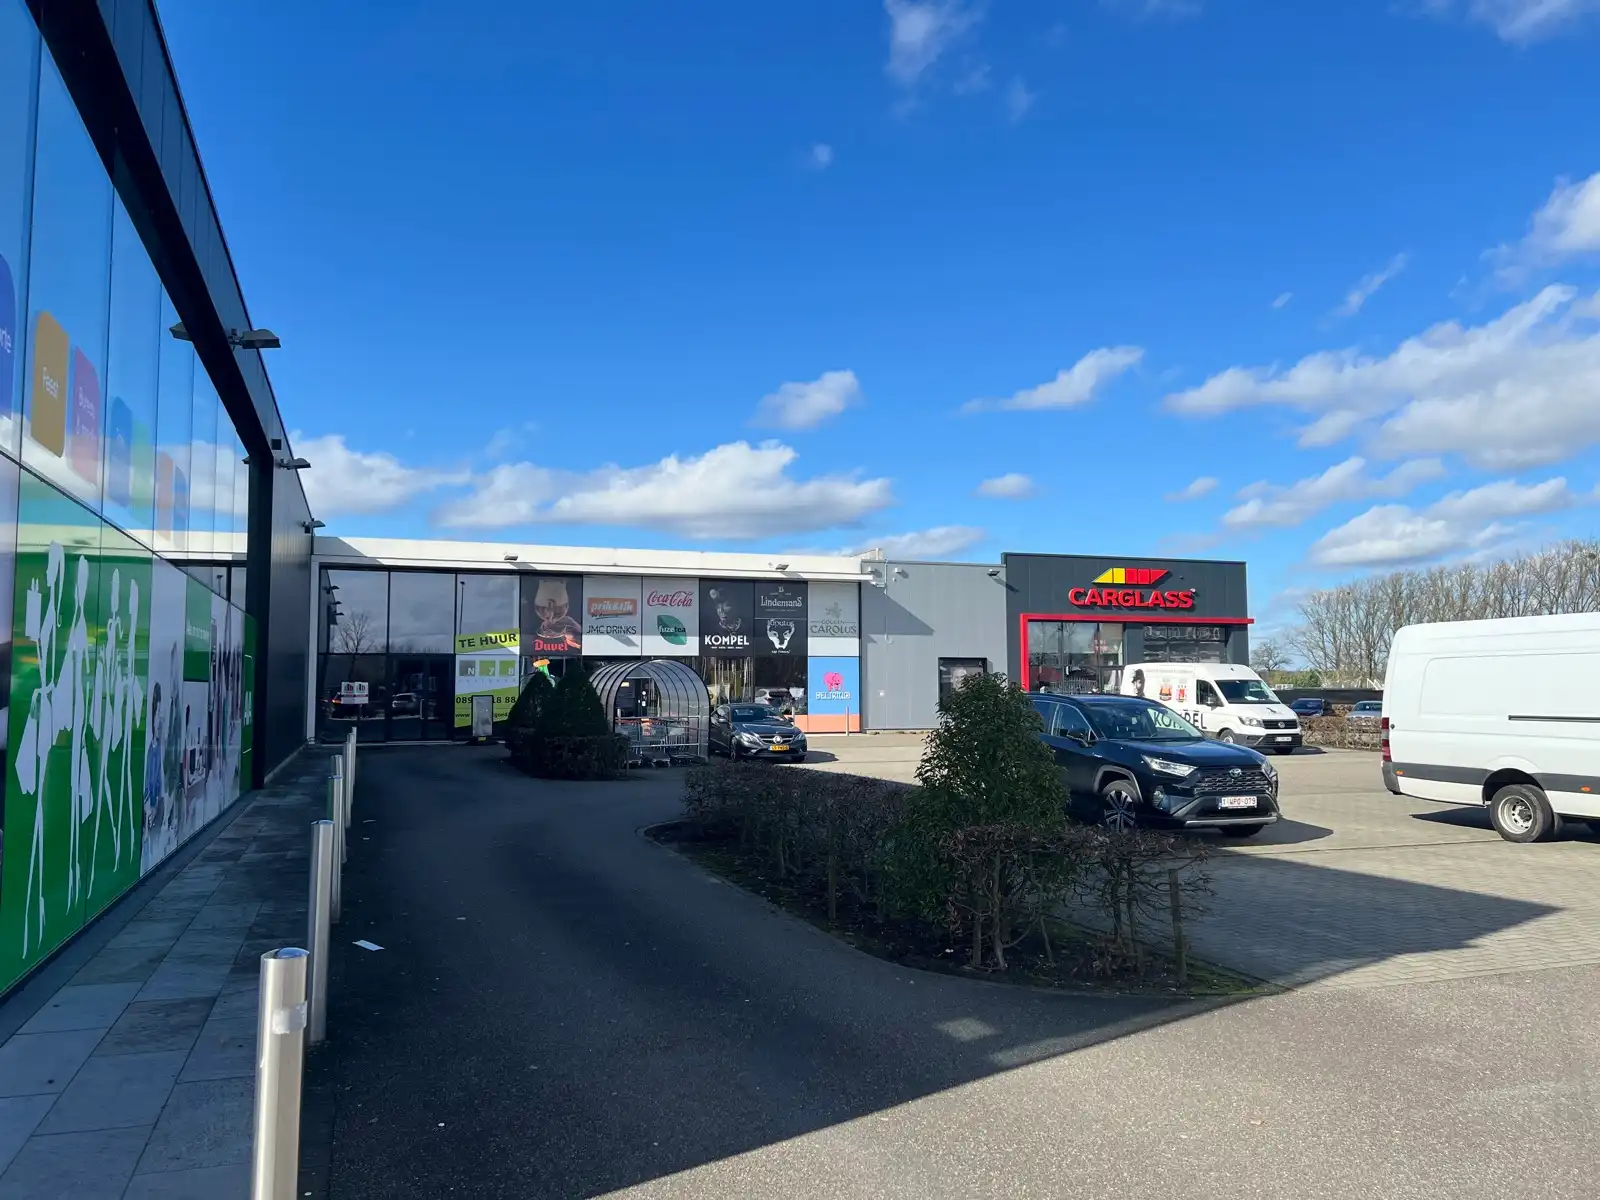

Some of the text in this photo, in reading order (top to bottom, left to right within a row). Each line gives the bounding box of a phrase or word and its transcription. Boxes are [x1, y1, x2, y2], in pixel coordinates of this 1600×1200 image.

[647, 590, 694, 607] Coca-Cola
[1068, 587, 1194, 609] CARGLASS
[587, 625, 637, 635] JMC DRINKS
[810, 624, 857, 635] CAROLUS
[459, 633, 517, 648] TE HUUR
[533, 639, 568, 652] Duvel
[704, 634, 750, 646] KOMPEL
